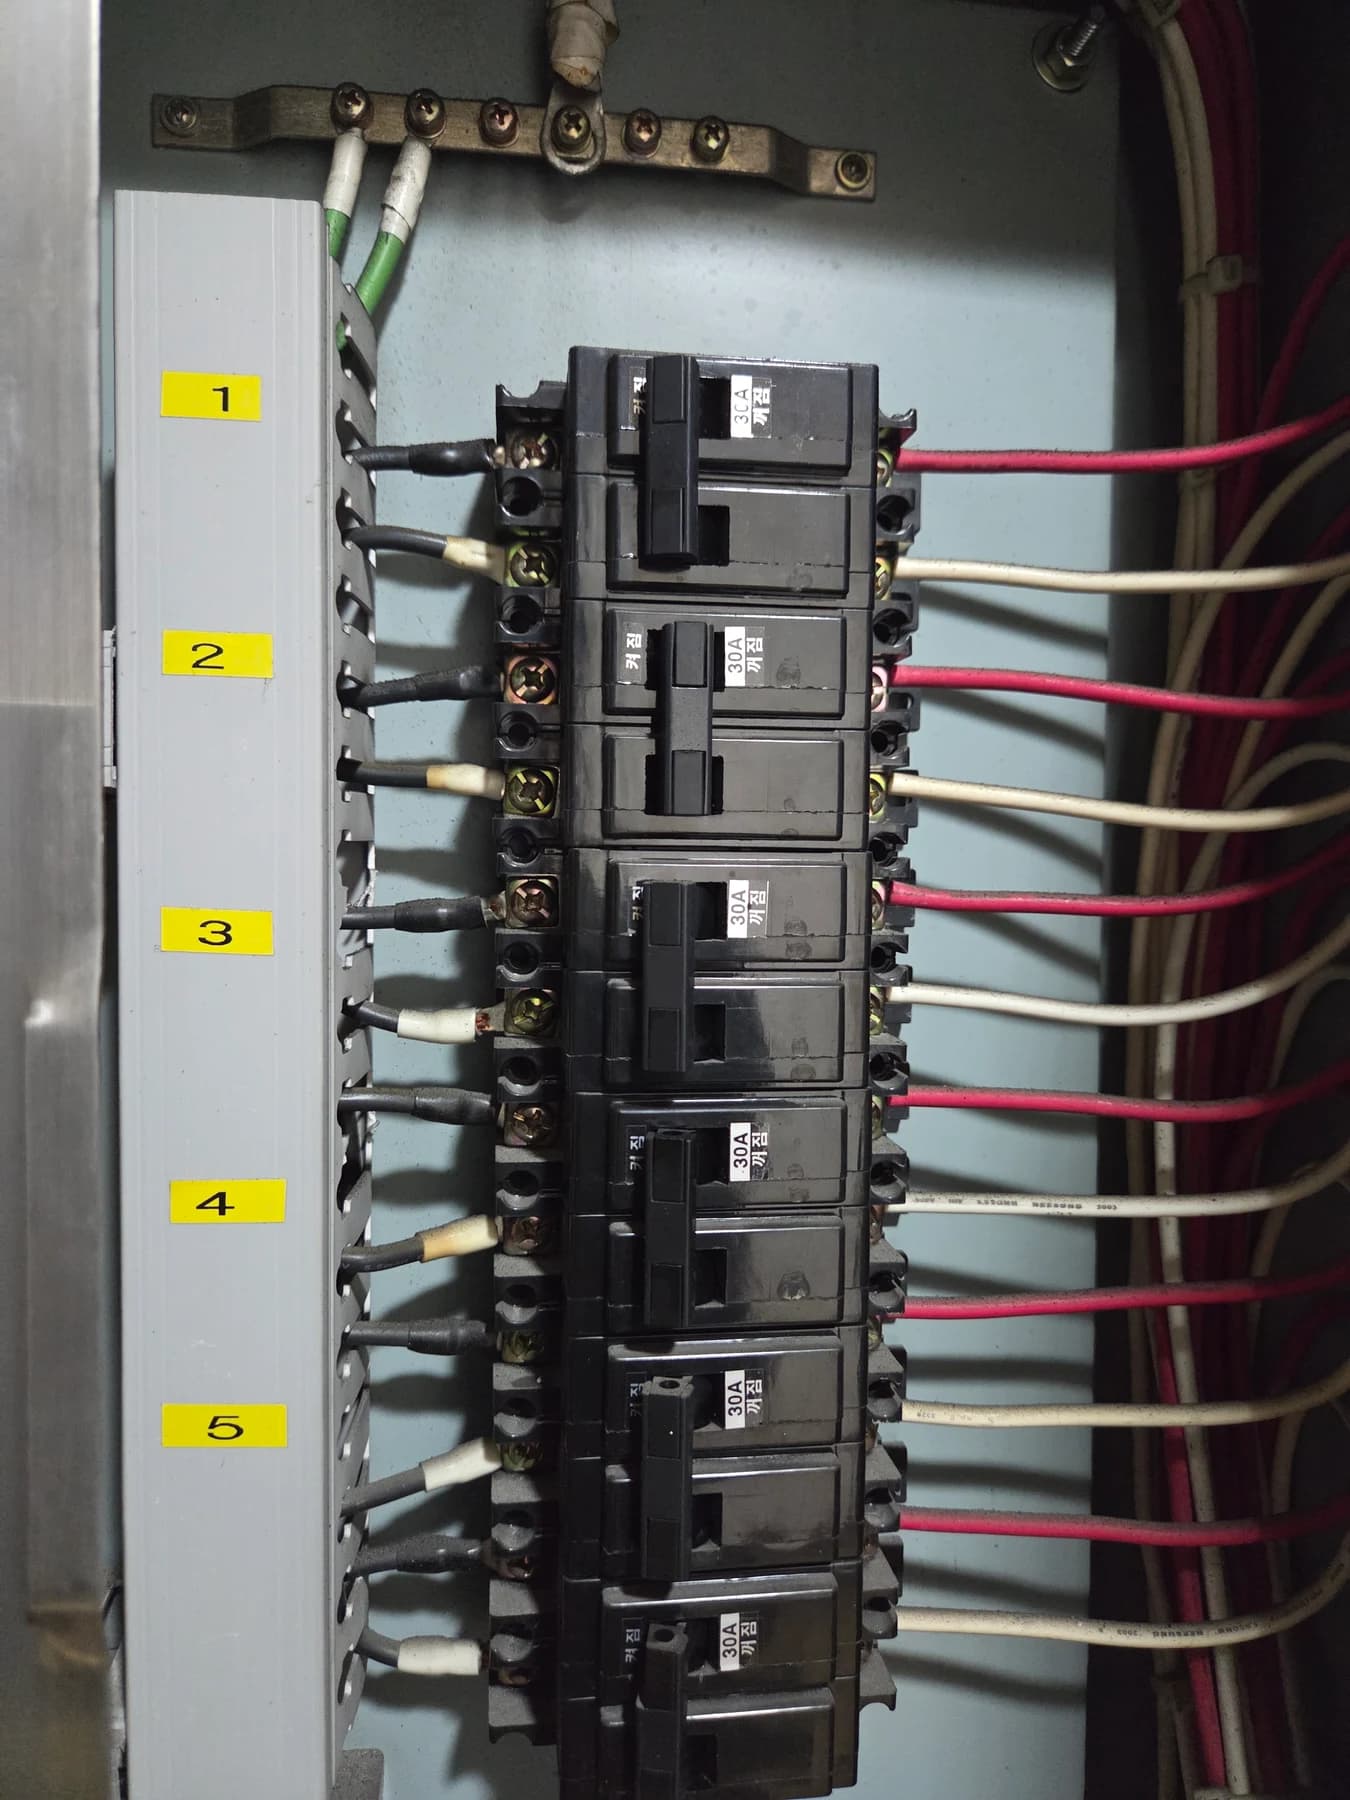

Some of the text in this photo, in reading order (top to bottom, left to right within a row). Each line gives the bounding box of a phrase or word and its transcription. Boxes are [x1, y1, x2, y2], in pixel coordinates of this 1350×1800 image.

[212, 386, 229, 412] 1
[751, 387, 771, 426] 꺼짐
[191, 643, 225, 670] 2
[625, 632, 642, 669] 켜짐
[728, 637, 743, 673] 30A
[745, 636, 764, 673] 꺼짐
[730, 890, 746, 925] 30A
[748, 890, 766, 926] 꺼짐
[198, 920, 233, 946] 3
[733, 1132, 749, 1169] 30A
[751, 1132, 768, 1168] 꺼짐
[195, 1191, 235, 1216] 4
[728, 1380, 743, 1416] 30A
[746, 1379, 763, 1415] 꺼짐
[207, 1415, 244, 1441] 5
[722, 1623, 738, 1658] 30A
[741, 1623, 757, 1658] 꺼짐
